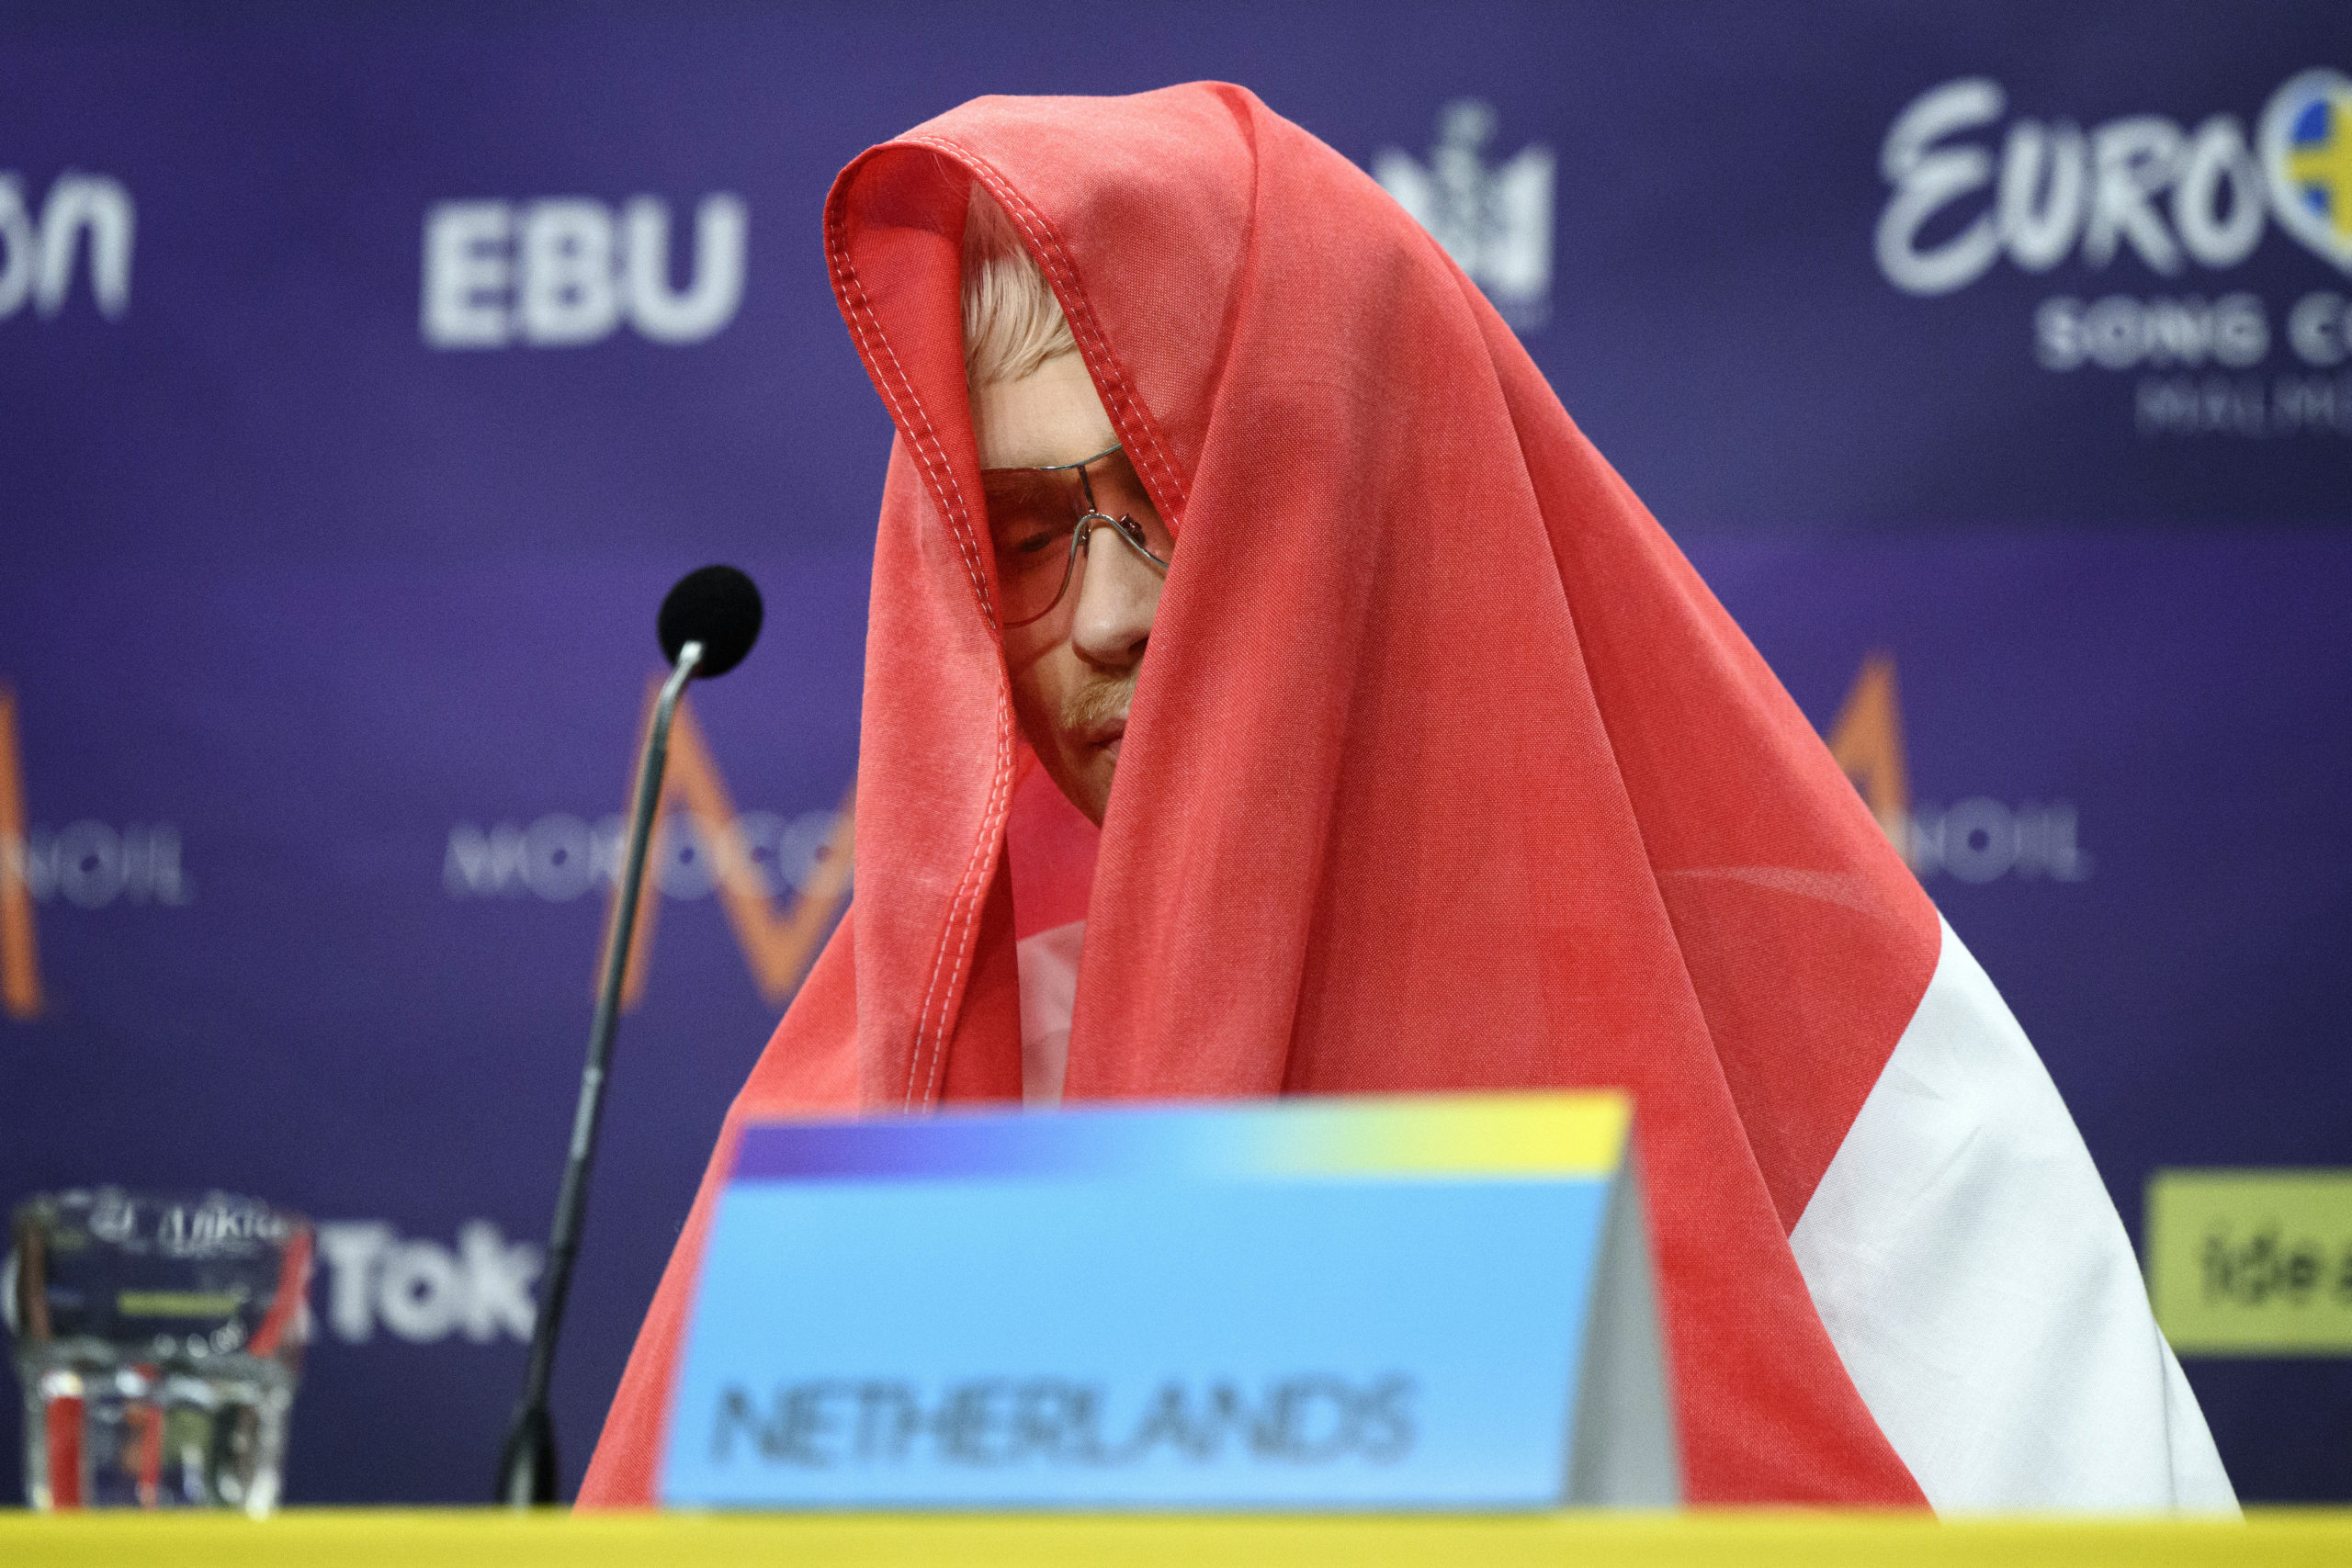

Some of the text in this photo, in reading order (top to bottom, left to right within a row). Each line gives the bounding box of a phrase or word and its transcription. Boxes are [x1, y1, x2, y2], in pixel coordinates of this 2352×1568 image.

[421, 193, 748, 349] EBU
[2034, 289, 2352, 370] SONG C
[303, 1219, 544, 1344] Tok
[708, 1371, 1419, 1470] NETHERLANDS
